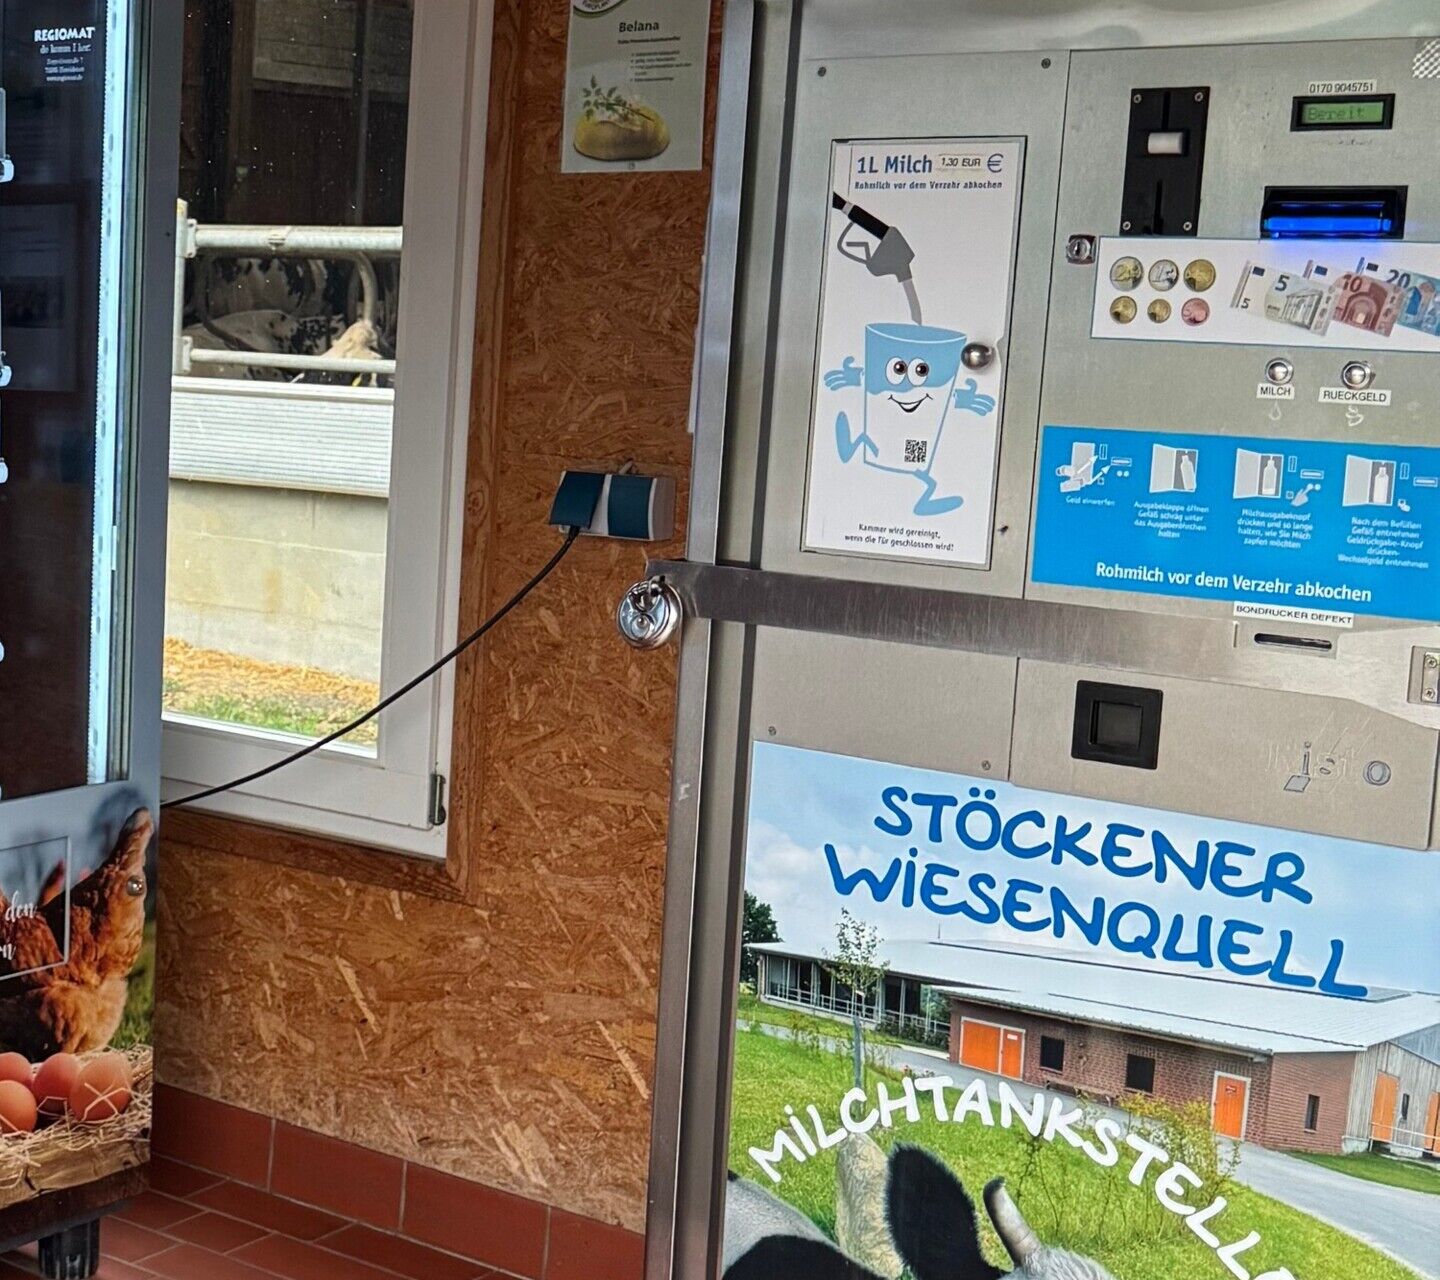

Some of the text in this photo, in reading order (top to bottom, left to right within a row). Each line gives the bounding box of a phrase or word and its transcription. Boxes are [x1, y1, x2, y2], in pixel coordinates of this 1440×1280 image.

[34, 26, 95, 42] REGIOMAT
[618, 20, 660, 33] Belana
[1310, 83, 1333, 93] 0170
[885, 154, 933, 174] Milch
[962, 158, 981, 167] EUR
[987, 153, 1004, 174] €
[910, 181, 926, 190] dem
[930, 181, 960, 190] Verzehr
[963, 180, 1003, 189] abkochen
[1275, 275, 1290, 292] 5
[1342, 273, 1362, 293] 10
[1386, 269, 1411, 289] 20
[1260, 385, 1291, 397] MILCH
[1323, 390, 1387, 403] RUECKGELD
[888, 527, 904, 535] wird
[890, 539, 934, 549] geschlossen
[1096, 561, 1372, 602] Rohmilch vor dem Verzehr abkochen
[1236, 605, 1352, 624] BONDRUCKER DEFEKT
[874, 785, 1313, 904] STÖCKENER
[5, 890, 37, 923] den
